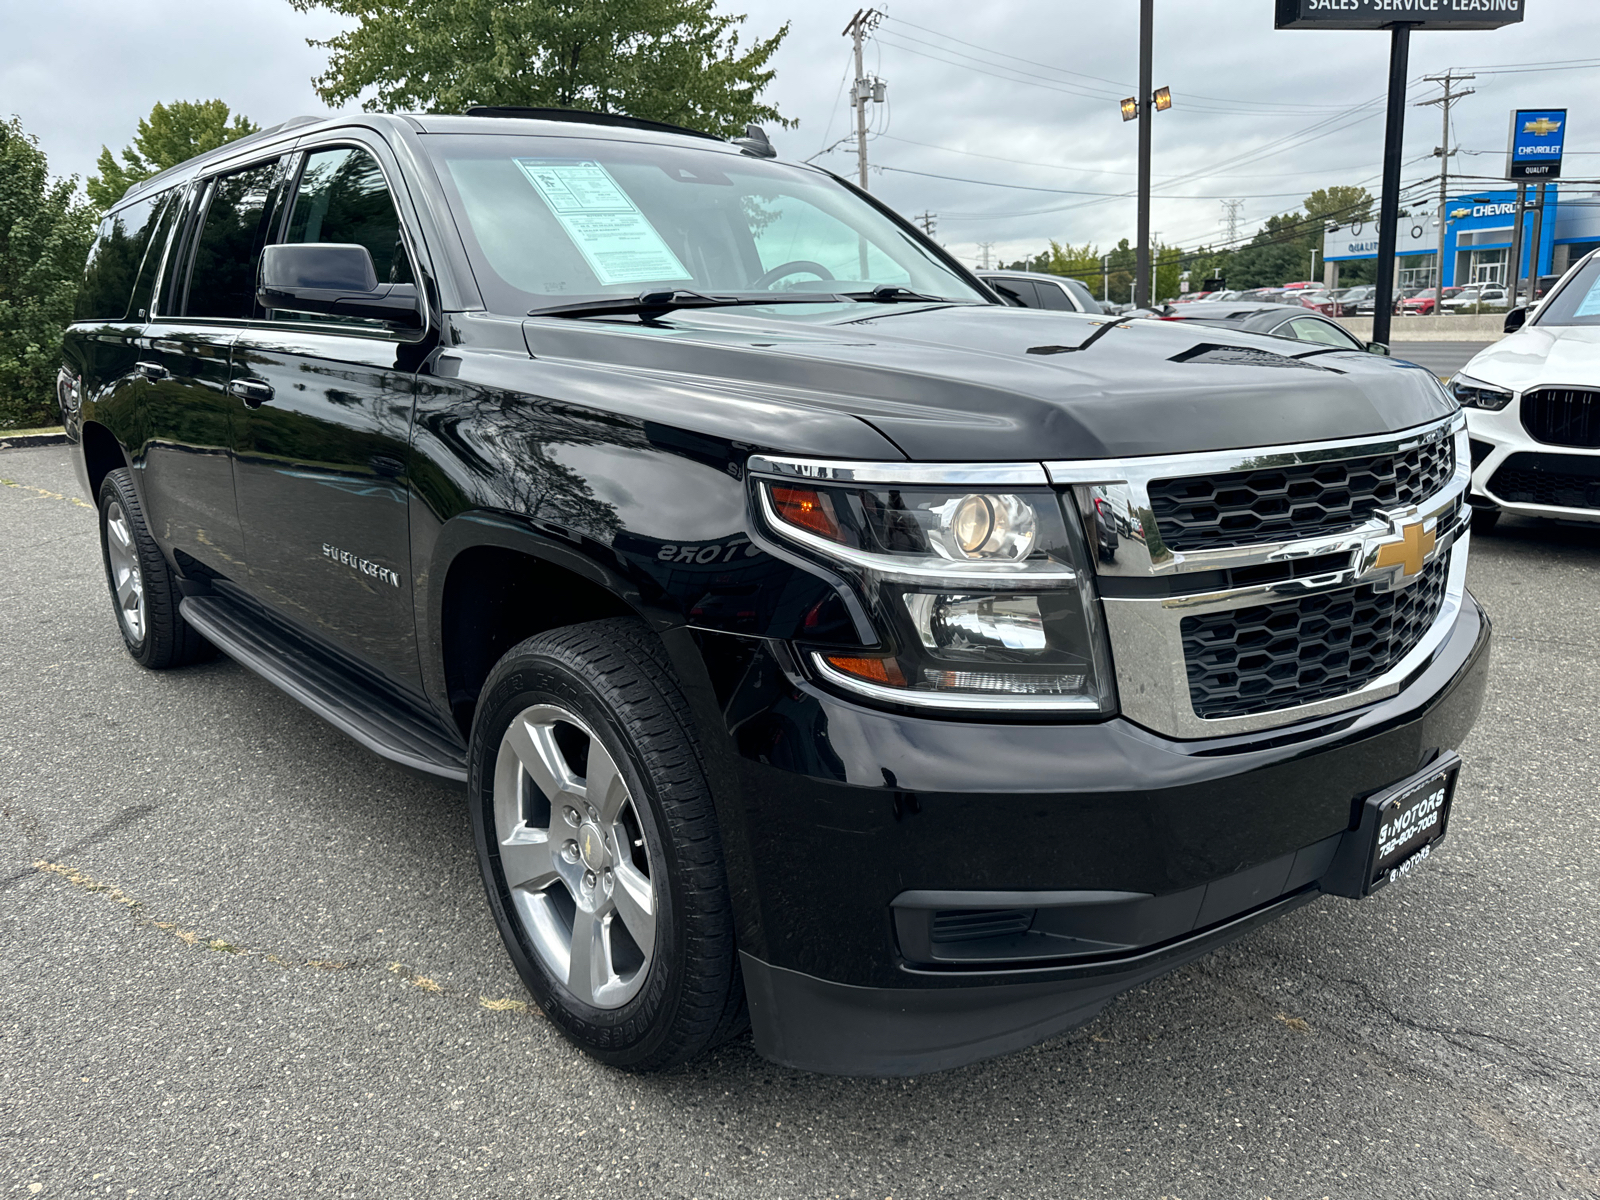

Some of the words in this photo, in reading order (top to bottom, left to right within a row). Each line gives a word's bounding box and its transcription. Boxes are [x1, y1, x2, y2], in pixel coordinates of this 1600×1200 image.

[1308, 0, 1359, 11] SALES
[1373, 0, 1439, 11] SERVICE
[1452, 0, 1519, 11] LEASING
[1518, 145, 1561, 155] CHEVROLET
[1525, 166, 1549, 174] QUALITY
[1348, 241, 1378, 253] QUALIT
[321, 542, 401, 588] SUBURBAN
[1379, 810, 1438, 860] 732-800-7003
